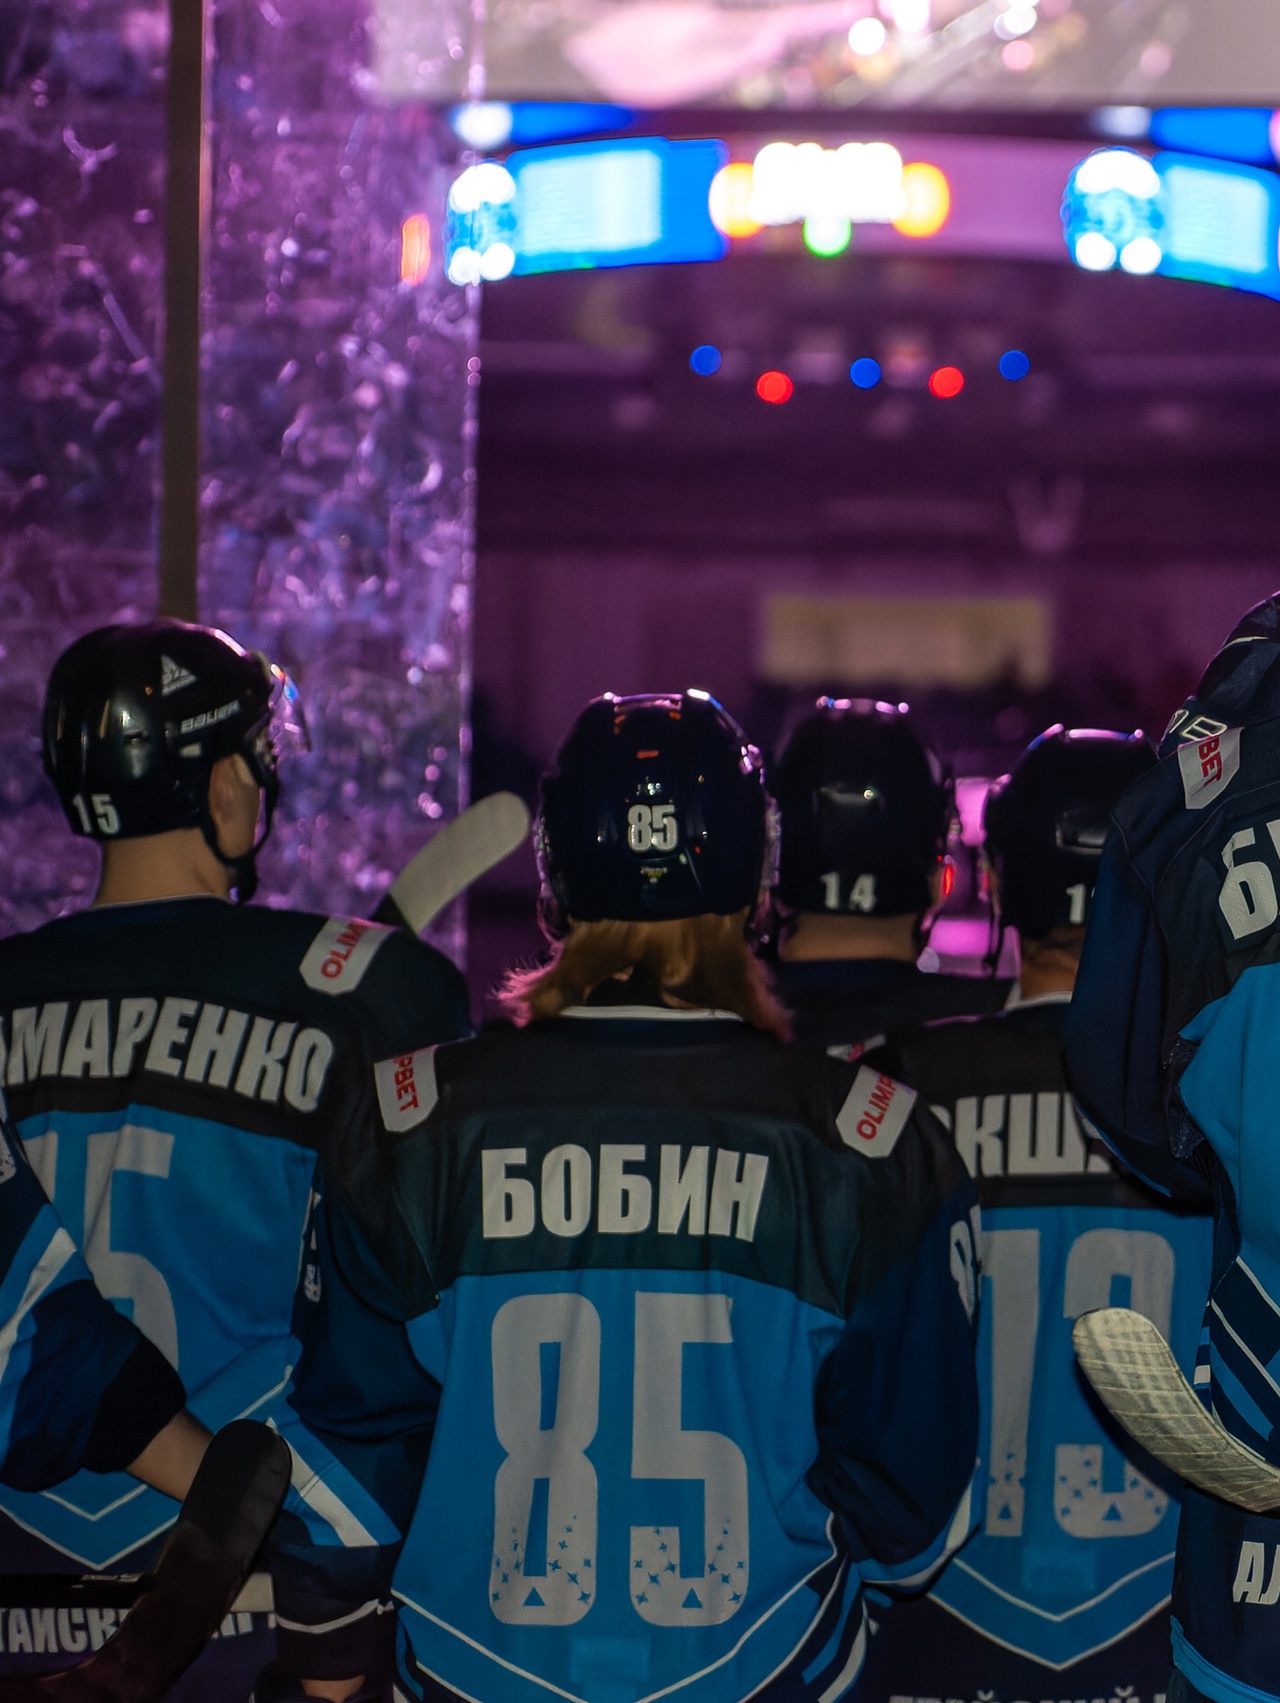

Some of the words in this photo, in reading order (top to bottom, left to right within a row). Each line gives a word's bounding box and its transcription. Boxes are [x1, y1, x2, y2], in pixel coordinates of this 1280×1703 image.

[73, 795, 121, 835] 15
[627, 803, 679, 853] 85
[820, 872, 877, 913] 14
[0, 997, 334, 1114] МАРЕНКО
[480, 1143, 769, 1243] БОБИН
[488, 1290, 750, 1627] 85
